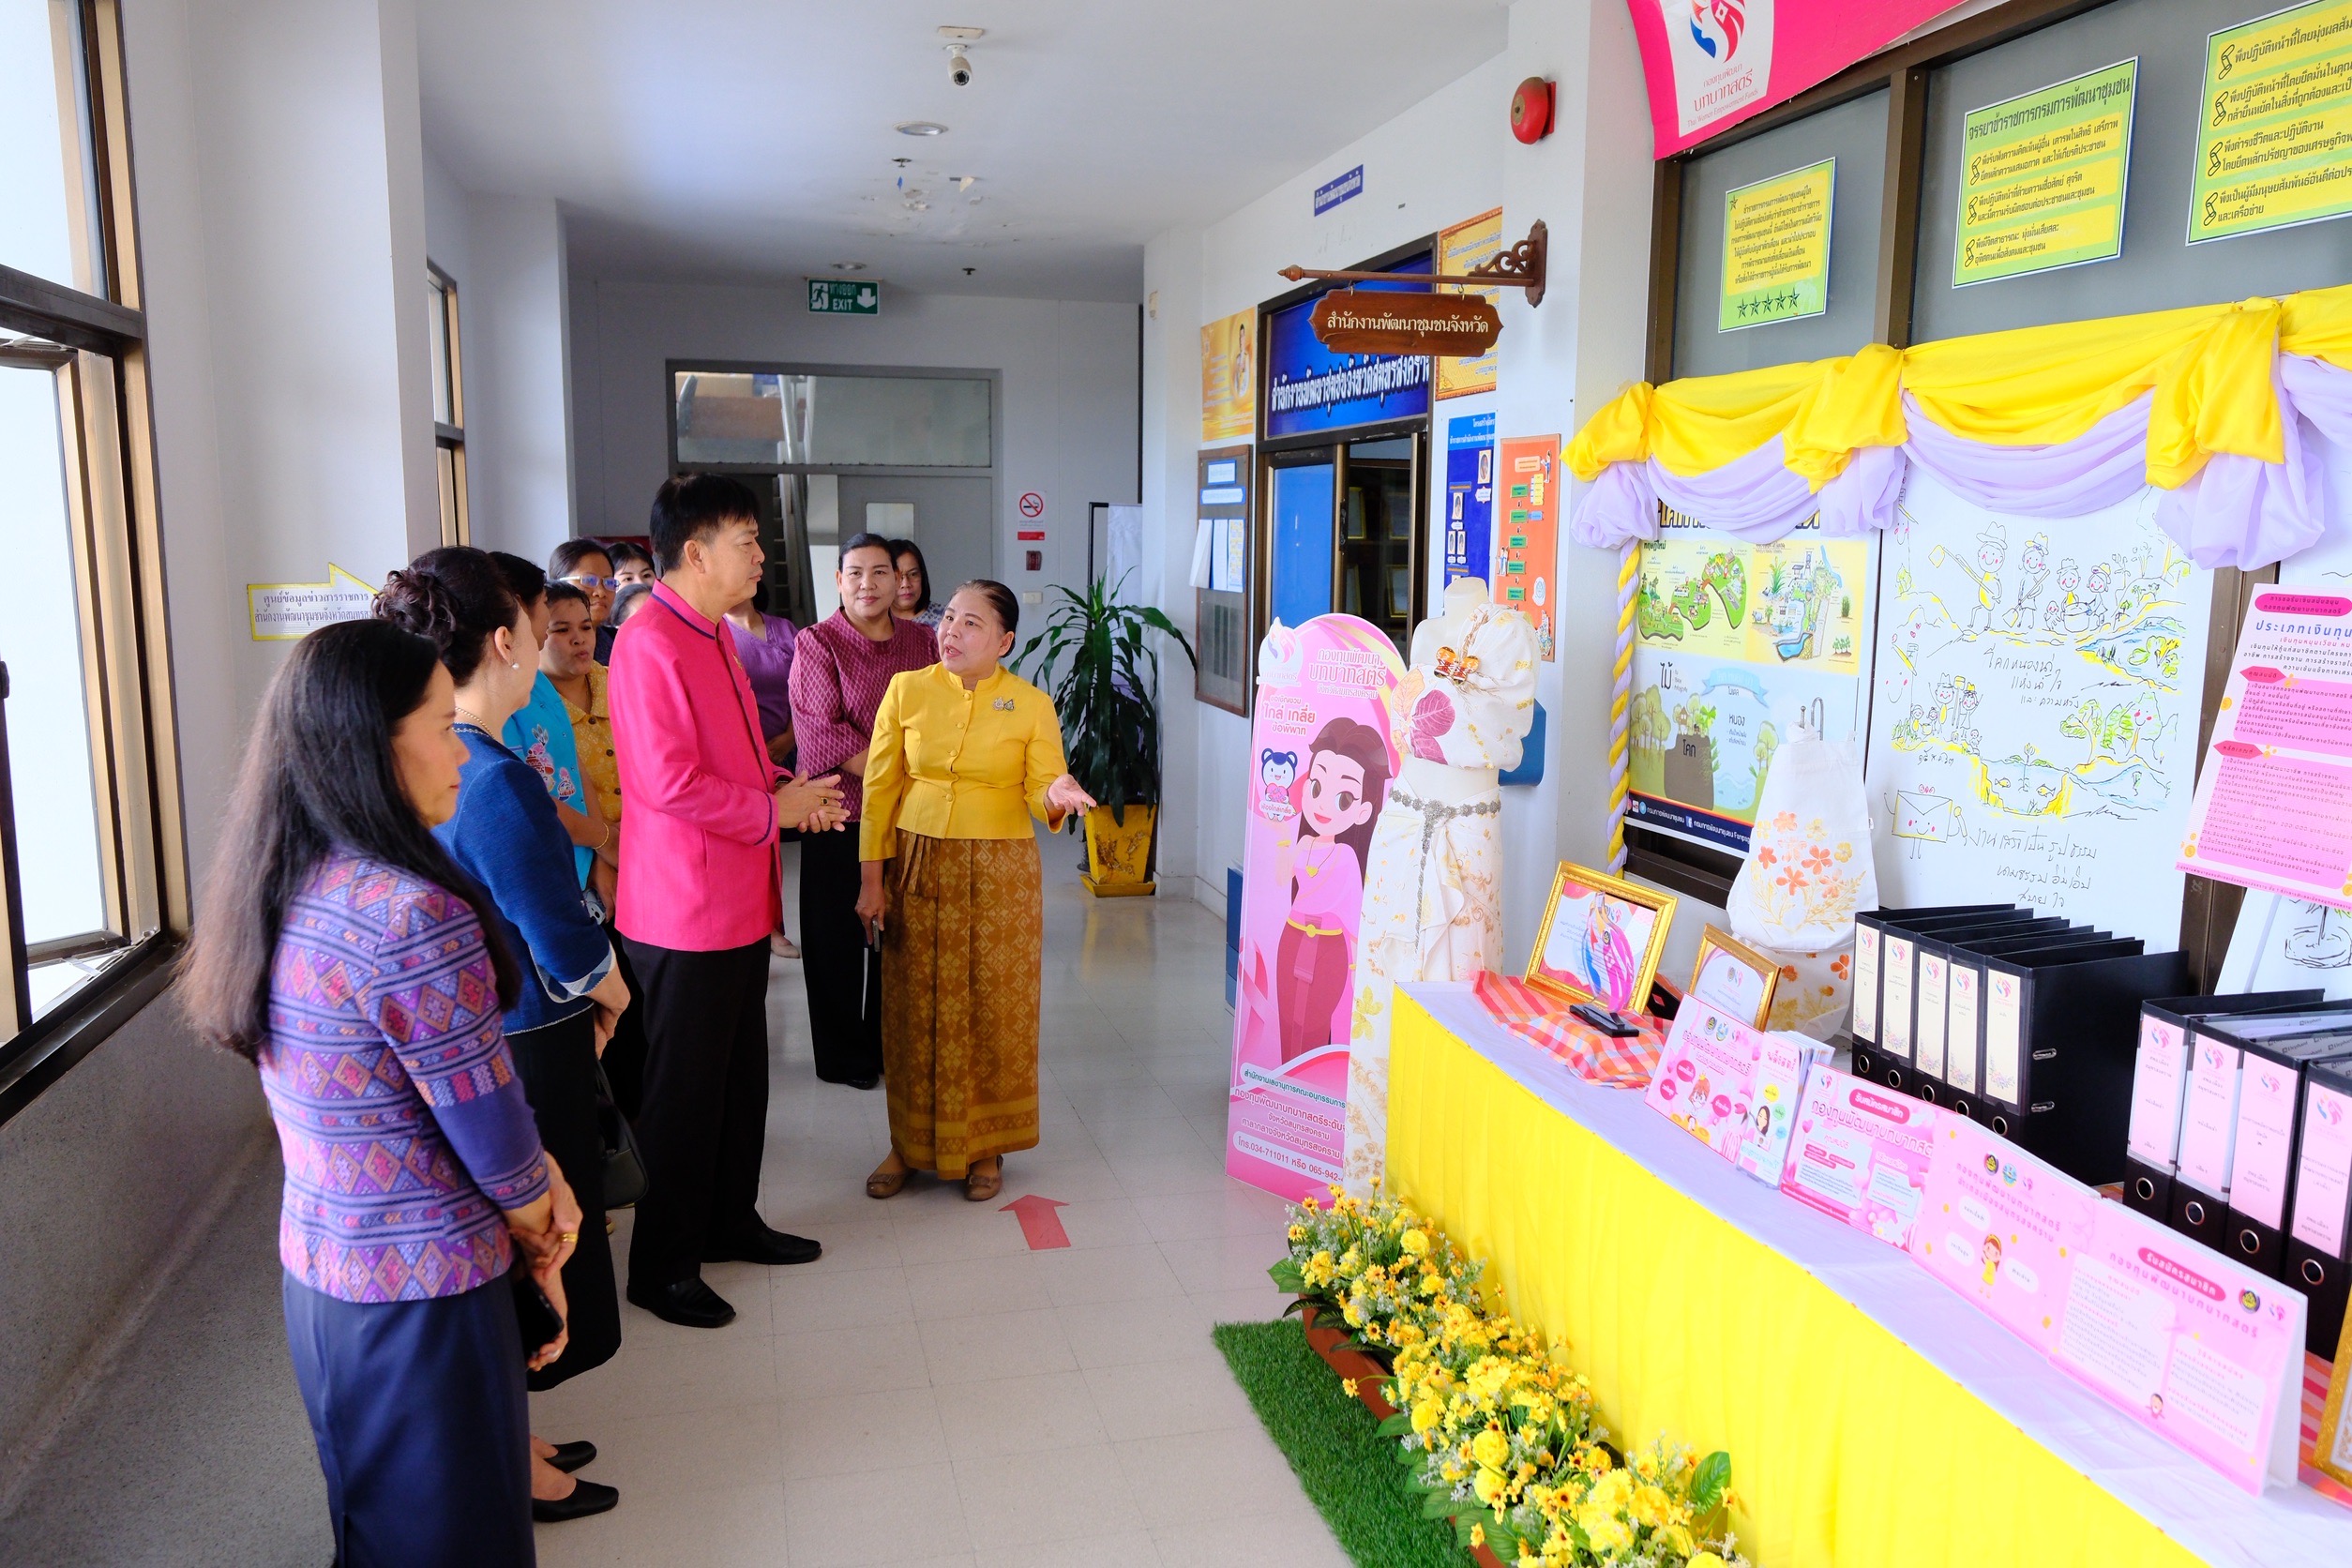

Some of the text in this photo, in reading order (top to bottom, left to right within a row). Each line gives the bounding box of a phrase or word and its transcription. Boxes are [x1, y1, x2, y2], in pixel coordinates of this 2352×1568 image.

[1694, 68, 1753, 112] บทบาทสตรี
[1968, 77, 2131, 140] จรรยาข้าราชการกรมการพัฒนาชุมชน
[2224, 119, 2324, 153] พึงดำรงชีวิตและปฏิบัติงาน
[2217, 204, 2265, 222] และเครือข่าย
[832, 298, 853, 310] EXIT
[1327, 310, 1488, 338] สำนักงานพัฒนาชุมชนจังหวัด
[263, 590, 369, 608] ศูนย์ข้อมูลข่าวสารราชการ
[1318, 648, 1380, 666] กองทุนพัฒนา
[1309, 663, 1386, 686] บทบาทสตรี
[1660, 661, 1673, 689] ไม้
[1288, 703, 1316, 723] เกลี่ย
[1728, 714, 1745, 726] หนอง
[1272, 723, 1306, 735] ข้อพิพาท
[1682, 739, 1696, 757] โคก
[2287, 1041, 2308, 1051] Elephant
[1244, 1068, 1346, 1108] สำนักงานเลขานุการคณะอนุกรรมการ
[1854, 1093, 1905, 1119] รับสมัครสมาชิก
[1242, 1117, 1340, 1159] ศาลากลางจังหวัดสมุทรสงคราม
[1268, 1113, 1330, 1140] จังหวัดสมุทรสงคราม
[1811, 1100, 1934, 1158] กองทุนพัฒนาบทบาทสต
[1238, 1136, 1289, 1164] โทร.034-711011
[1291, 1158, 1307, 1170] หรือ
[2145, 1252, 2217, 1296] รับสมัครสมาชิก
